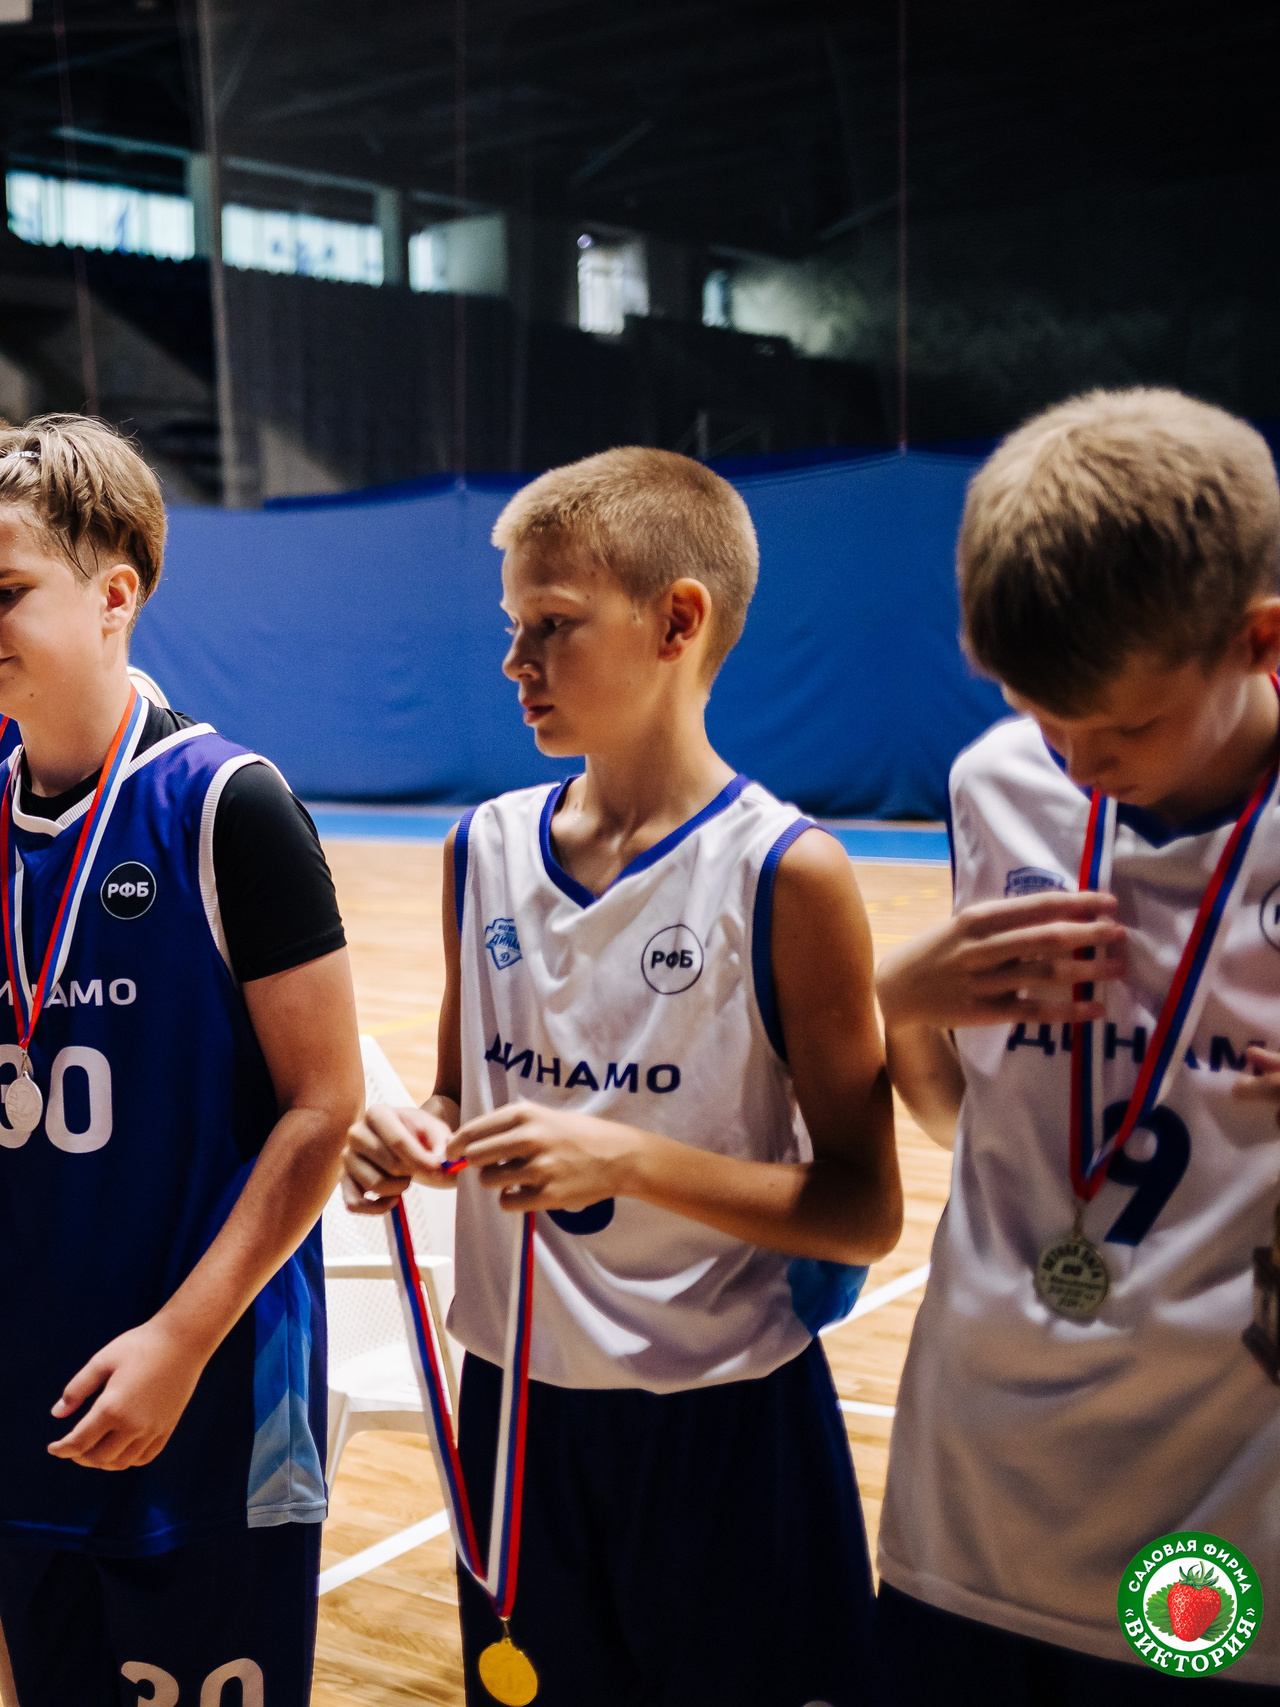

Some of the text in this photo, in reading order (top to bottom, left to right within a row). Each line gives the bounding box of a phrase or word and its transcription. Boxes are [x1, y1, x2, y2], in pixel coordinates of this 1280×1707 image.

[107, 881, 150, 899] РФБ
[651, 950, 694, 969] РФБ
[484, 1033, 681, 1094] ДИНАМО
[1103, 1102, 1191, 1247] 9
